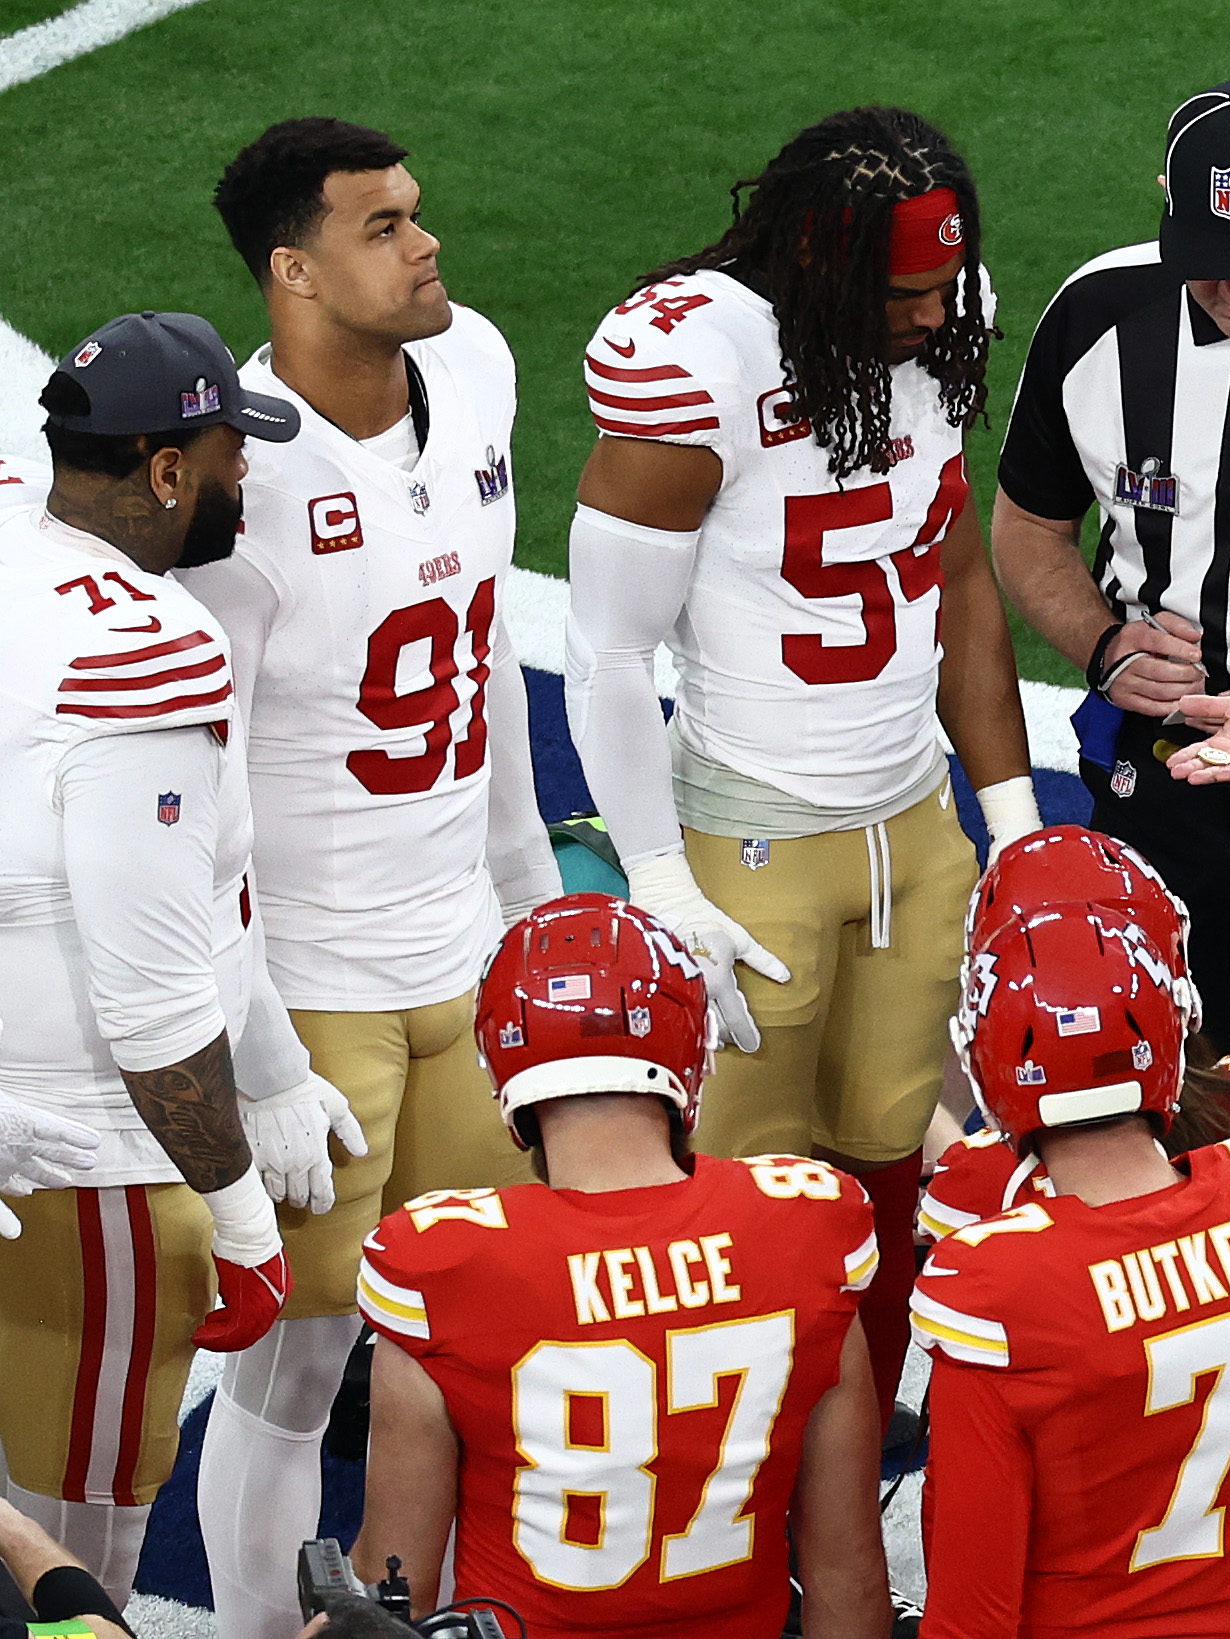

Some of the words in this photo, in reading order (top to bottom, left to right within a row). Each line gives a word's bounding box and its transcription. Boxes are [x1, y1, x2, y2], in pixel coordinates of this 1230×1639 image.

[313, 497, 357, 540] C
[418, 550, 462, 588] 49ERS
[780, 452, 970, 686] 54
[55, 571, 157, 615] 71
[345, 575, 497, 796] 91
[1112, 775, 1133, 794] NFL
[744, 849, 770, 864] NFL
[567, 1232, 742, 1326] KELCE
[511, 1308, 796, 1592] 87
